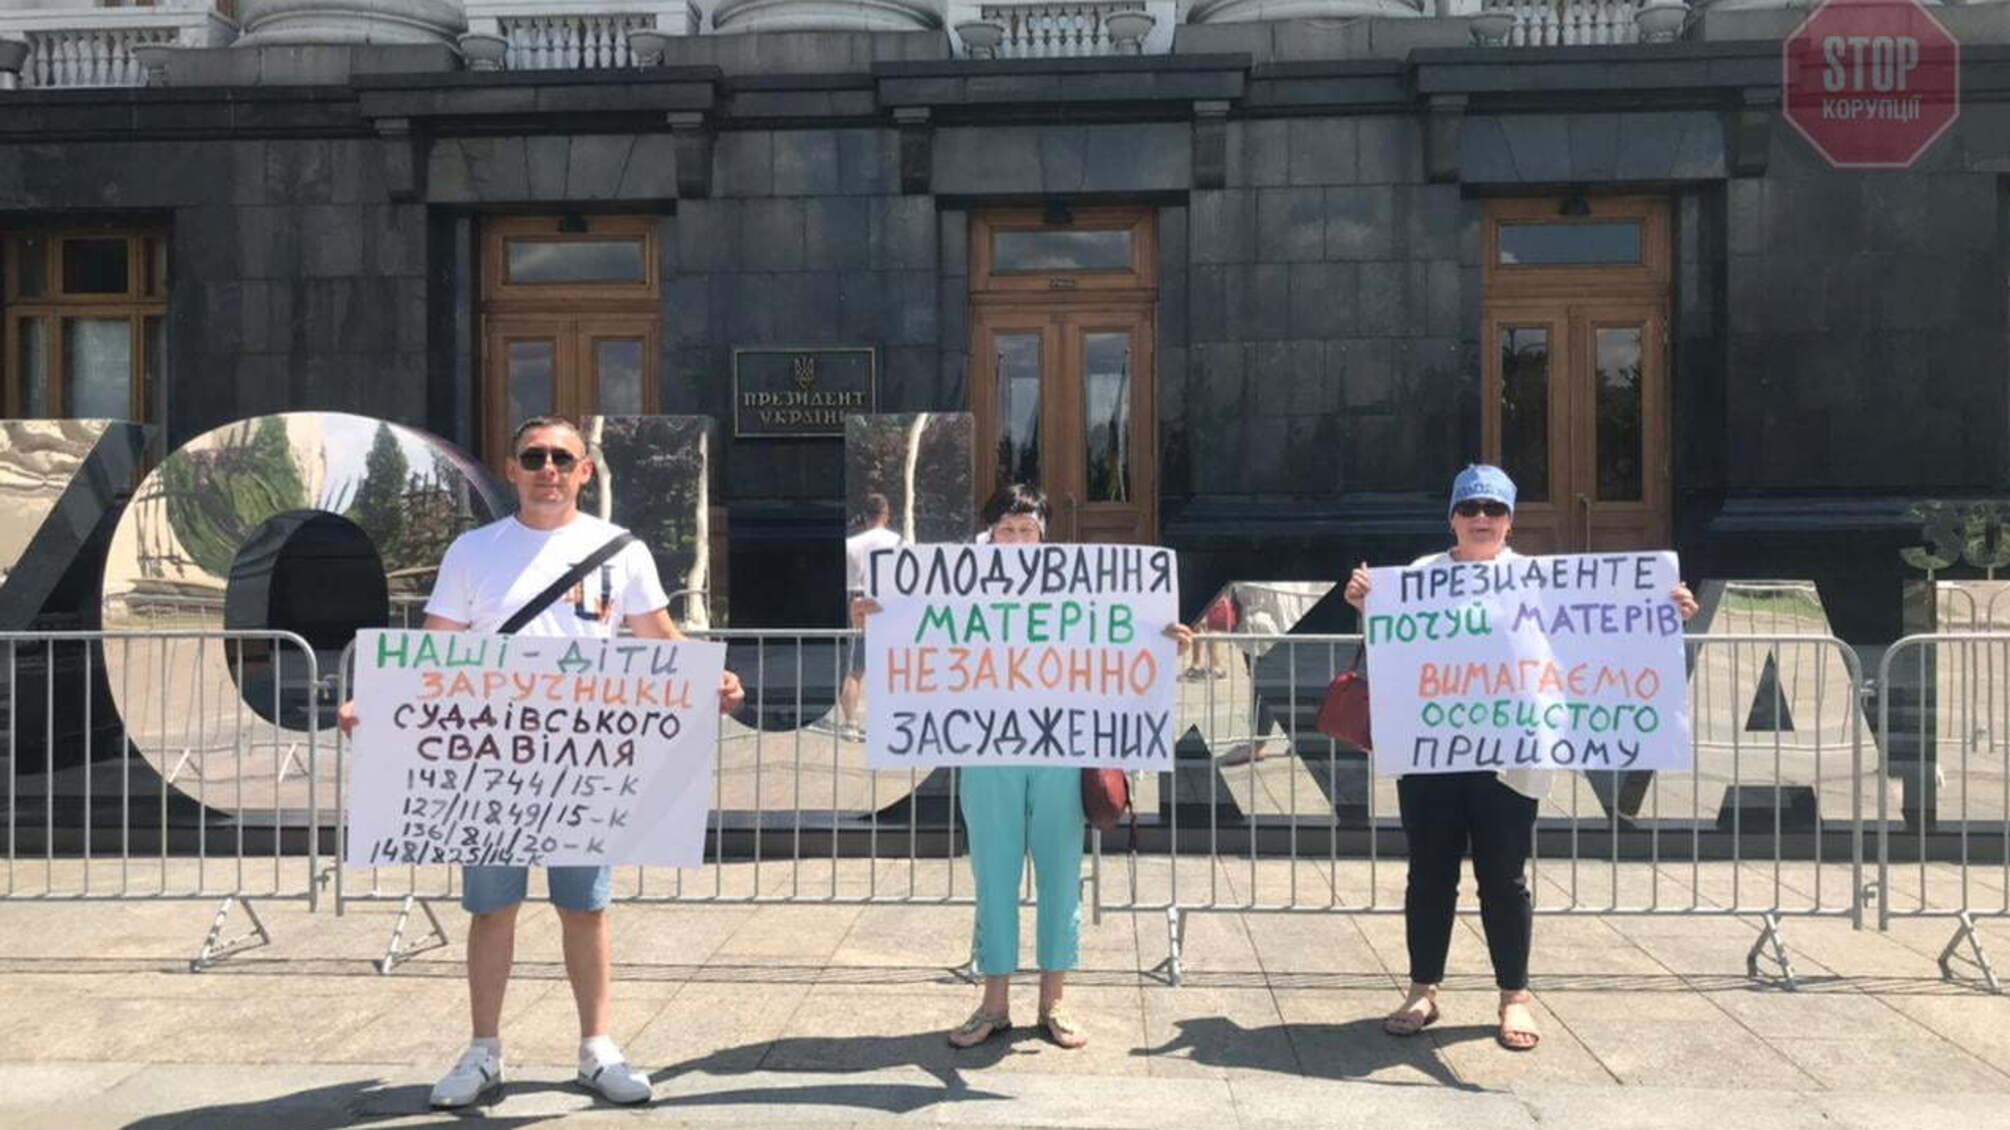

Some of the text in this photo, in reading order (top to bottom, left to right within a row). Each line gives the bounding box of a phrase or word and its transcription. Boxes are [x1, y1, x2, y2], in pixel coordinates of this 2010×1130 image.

[743, 391, 864, 406] ПРЕЗИДЕНТ
[869, 546, 1172, 597] ГОЛОДУВАННЯ
[1400, 556, 1657, 602] ПРЕЗИДЕНТЕ
[915, 601, 1135, 644] МАТЕРІВ
[1368, 599, 1679, 645] ПОЧУЙ МАТЕРІВ
[377, 632, 508, 669] НАШІ
[557, 639, 678, 674] ДІТИ
[887, 647, 1157, 694] НЕЗАКОННО
[417, 671, 692, 708] ЗАРУЧНИКИ
[1418, 660, 1660, 700] ВИМАГАЄМО
[394, 703, 680, 739] СУДДІВСЬКОГО
[887, 707, 1170, 758] ЗАСУДЖЕНИХ
[1421, 699, 1659, 733] ОСОБИСТОГО
[417, 734, 635, 767] СВАВІЛЛЯ
[1412, 729, 1640, 767] ПРИЙОМУ
